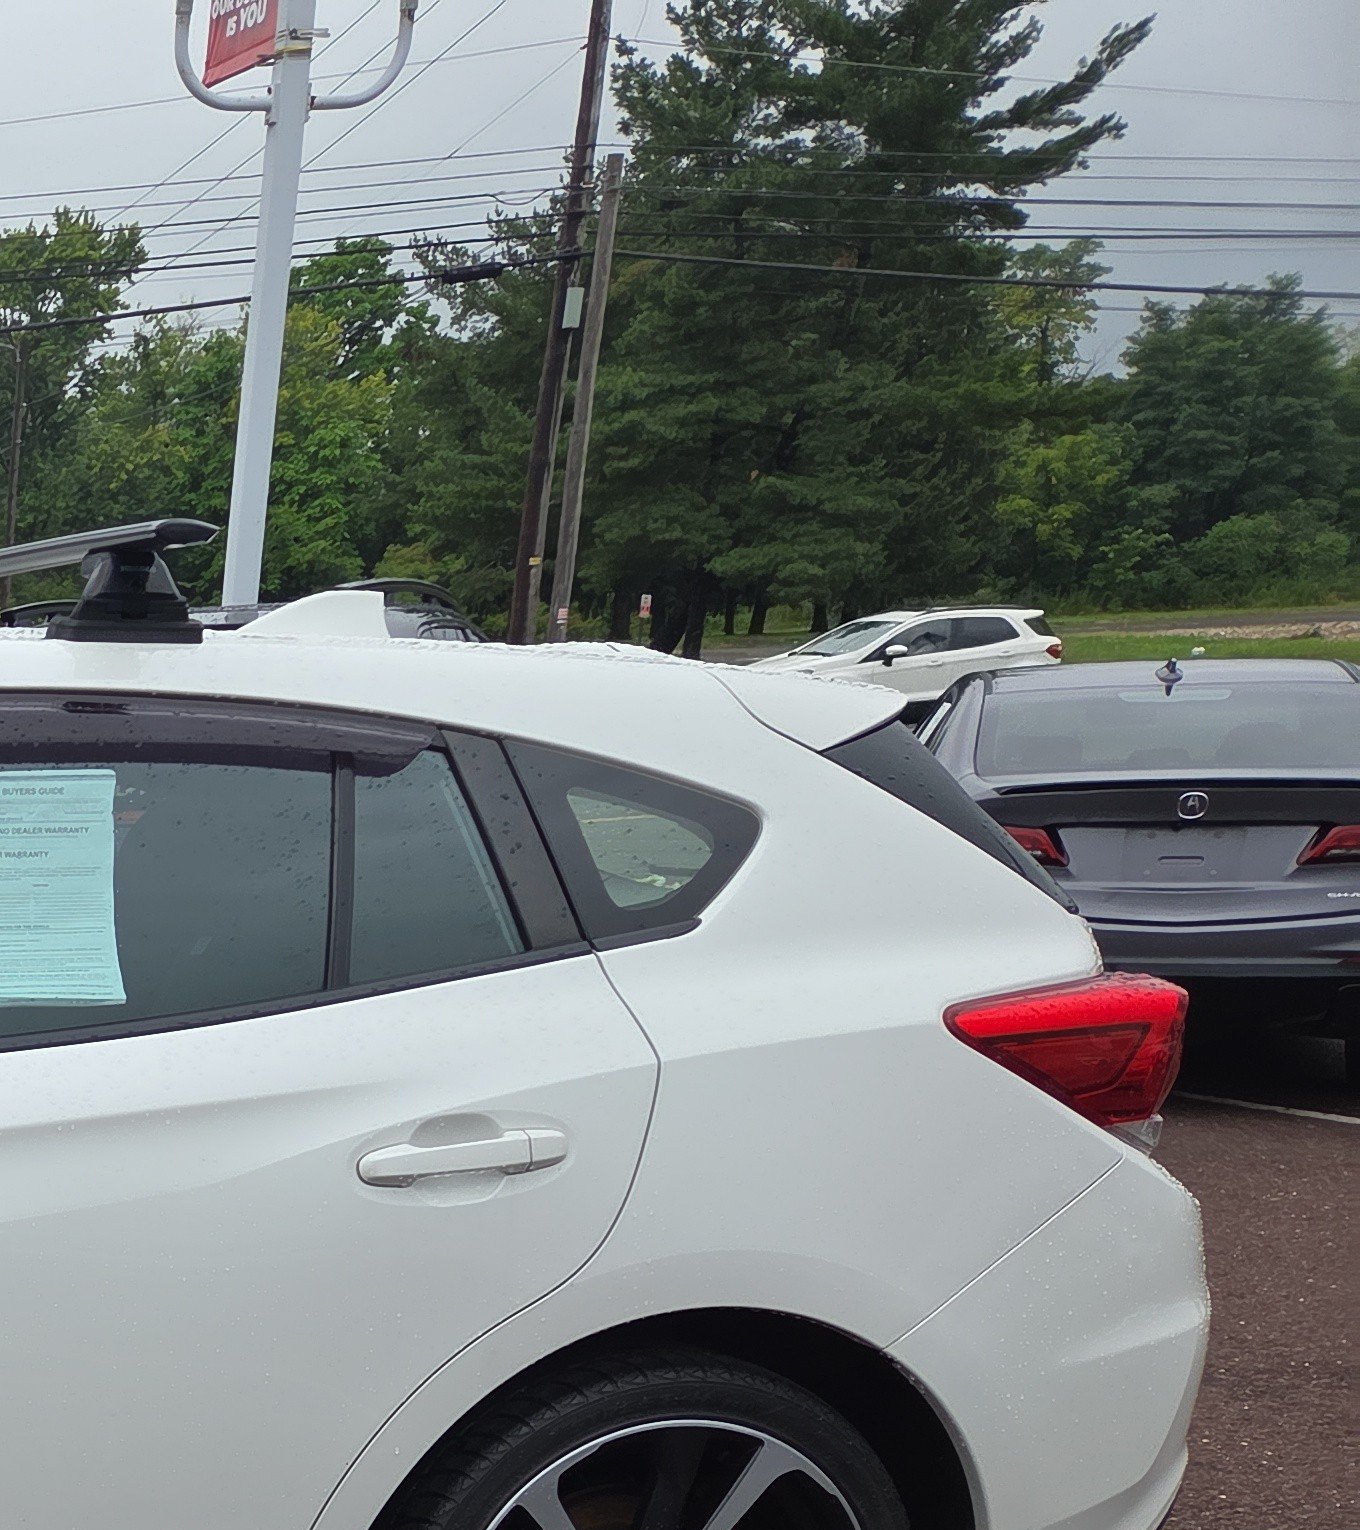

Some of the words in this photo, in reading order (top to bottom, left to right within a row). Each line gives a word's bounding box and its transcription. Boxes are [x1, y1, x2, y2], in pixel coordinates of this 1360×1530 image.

[240, 0, 268, 31] YOU
[1, 787, 37, 796] BUYERS
[38, 786, 65, 796] GUIDE
[11, 827, 43, 835] DEALER
[44, 826, 90, 834] WARRANTY
[4, 850, 49, 859] WARRANTY
